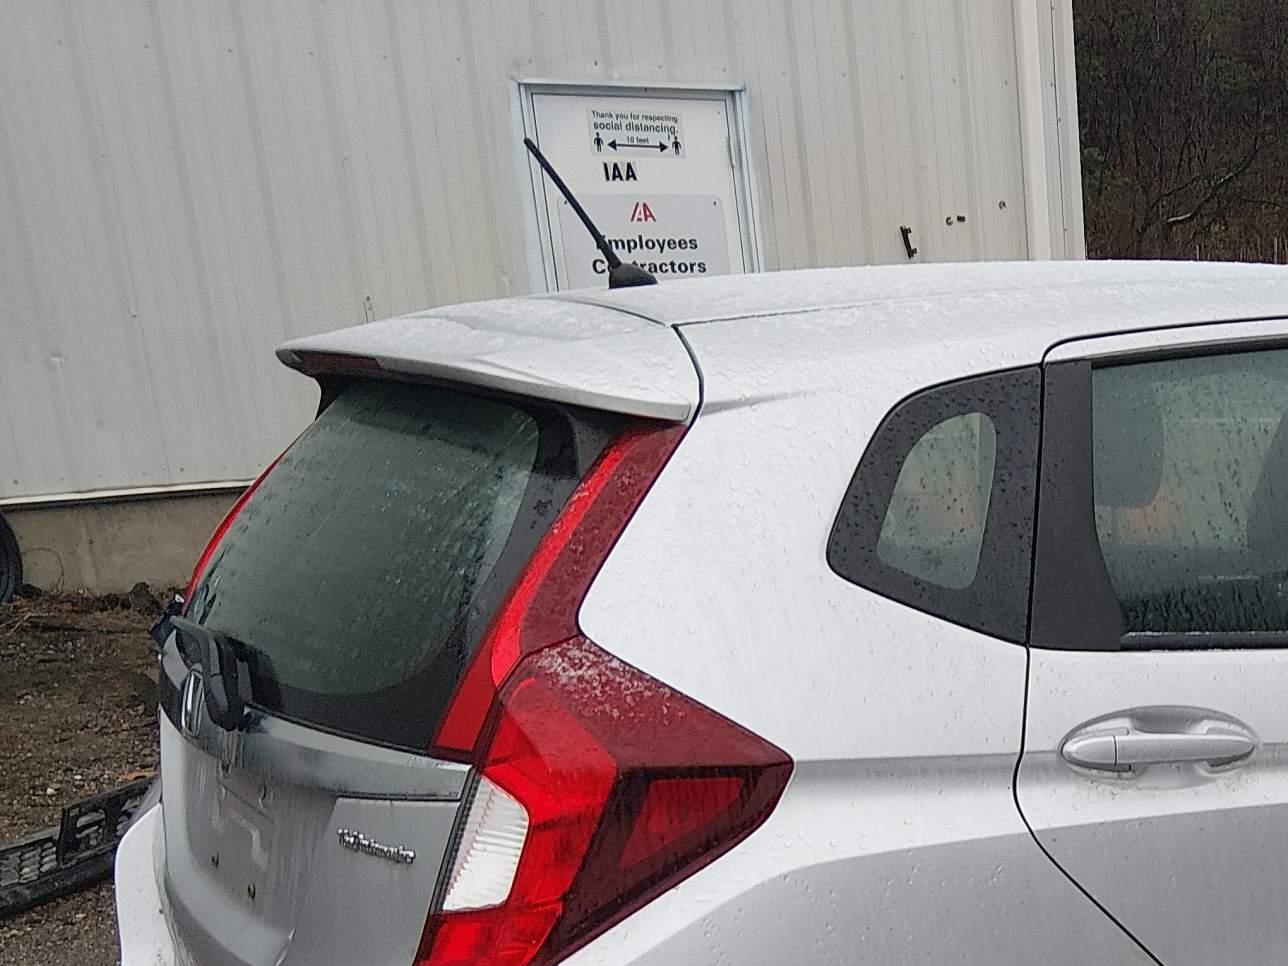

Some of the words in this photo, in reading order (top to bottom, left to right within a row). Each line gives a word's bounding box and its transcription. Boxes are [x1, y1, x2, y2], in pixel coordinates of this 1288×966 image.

[591, 110, 614, 119] Thank
[615, 112, 628, 121] you
[629, 112, 640, 120] for
[641, 114, 679, 125] respecting
[593, 120, 623, 131] social
[625, 122, 680, 137] distancing.
[636, 136, 650, 145] feet
[603, 162, 638, 181] IAA
